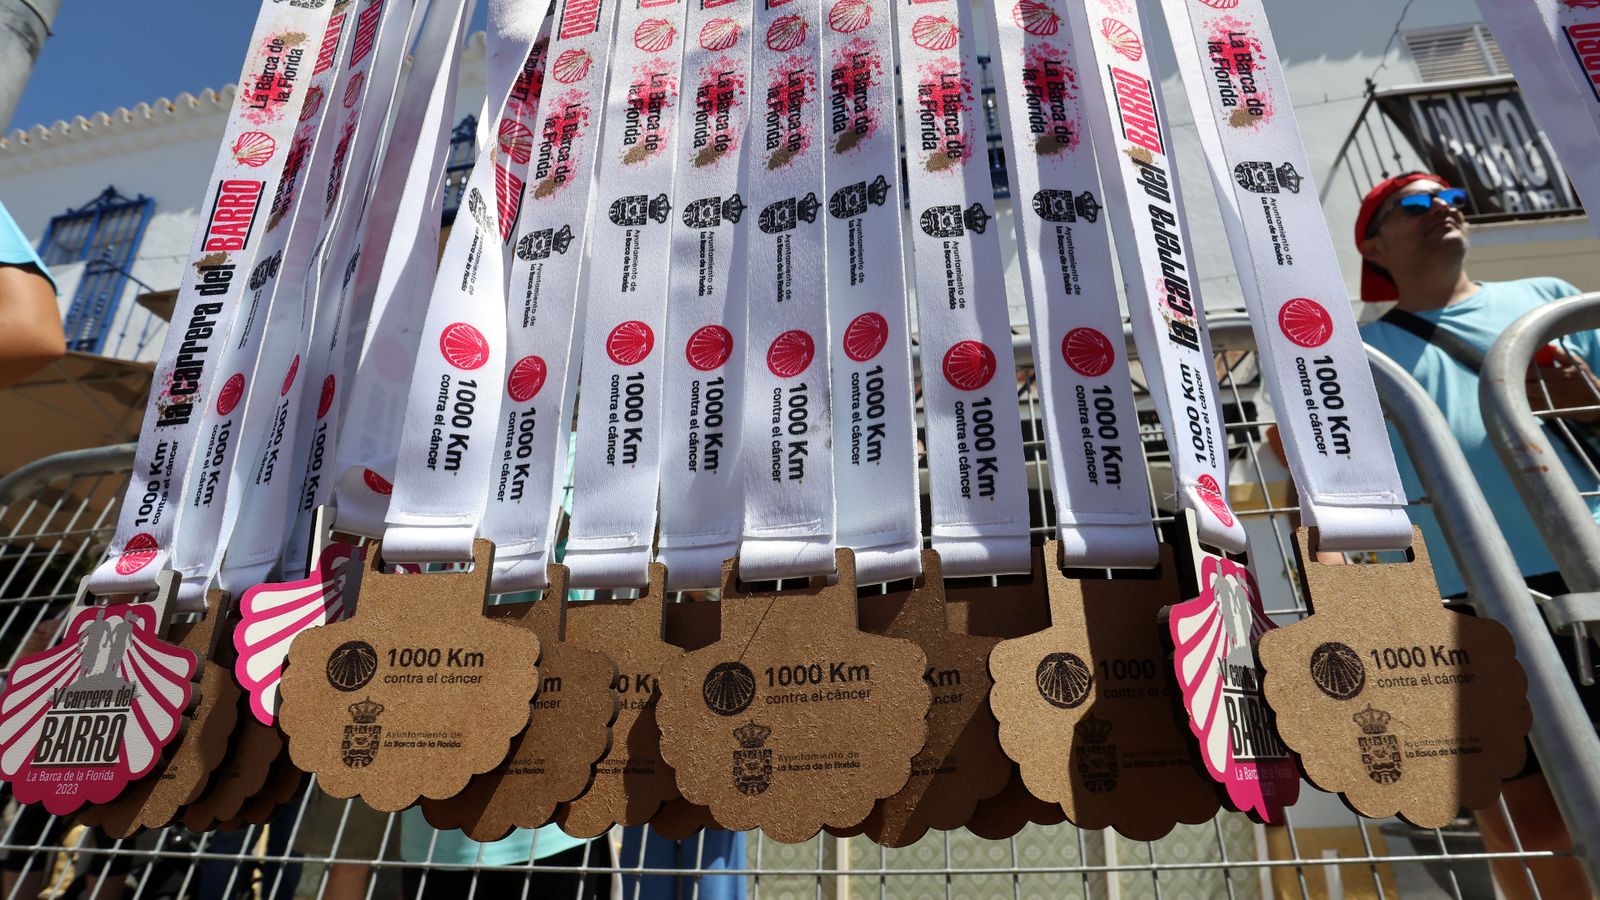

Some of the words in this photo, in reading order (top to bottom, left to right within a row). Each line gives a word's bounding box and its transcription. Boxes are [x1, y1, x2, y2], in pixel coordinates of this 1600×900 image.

[266, 38, 285, 53] de
[1207, 41, 1225, 54] la
[1227, 32, 1246, 49] La
[254, 56, 280, 90] Barca
[276, 48, 303, 88] Florida
[650, 72, 668, 88] La
[717, 71, 735, 89] La
[788, 69, 805, 88] La
[940, 73, 958, 90] La
[1022, 68, 1040, 82] la
[1044, 61, 1062, 77] La
[1213, 58, 1237, 107] Florida
[1235, 53, 1257, 94] Barca
[249, 94, 269, 109] La
[272, 91, 291, 102] la
[628, 83, 645, 96] la
[697, 85, 710, 100] la
[767, 86, 782, 100] la
[919, 84, 936, 97] la
[1045, 81, 1067, 122] Barca
[1246, 98, 1264, 117] de
[623, 98, 644, 145] Florida
[647, 92, 665, 131] Barca
[694, 101, 713, 148] Florida
[716, 91, 734, 132] Barca
[766, 101, 784, 151] Florida
[788, 89, 805, 132] Barca
[920, 100, 938, 151] Florida
[943, 94, 961, 137] Barca
[1026, 85, 1047, 133] Florida
[1112, 67, 1161, 154] BARRO
[644, 135, 661, 152] de
[715, 135, 730, 153] de
[787, 133, 804, 153] de
[947, 140, 963, 160] de
[1054, 126, 1071, 145] de
[1130, 157, 1172, 204] del
[205, 180, 262, 251] BARRO
[1269, 197, 1289, 252] Ayuntamiento
[1285, 255, 1293, 266] de
[631, 230, 641, 280] Ayuntamiento
[1065, 226, 1079, 282] Ayuntamiento
[1074, 284, 1081, 295] de
[1148, 204, 1194, 317] carrera
[195, 264, 236, 297] del
[630, 282, 637, 292] de
[169, 302, 223, 396] carrera
[1169, 320, 1200, 352] la
[436, 374, 450, 411] contra
[609, 374, 620, 411] contra
[851, 372, 861, 410] contra
[865, 365, 885, 419] 1000
[1182, 364, 1196, 402] Km
[1195, 368, 1207, 410] cáncer
[1295, 356, 1312, 396] contra
[1313, 355, 1344, 410] 1000
[156, 402, 192, 428] la
[451, 379, 477, 428] 1000
[624, 371, 644, 422] 1000
[690, 380, 700, 417] contra
[704, 376, 724, 428] 1000
[772, 387, 782, 424] contra
[787, 382, 808, 435] 1000
[1075, 384, 1089, 424] contra
[1092, 385, 1118, 440] 1000
[1305, 398, 1319, 410] el
[274, 399, 289, 446] 1000
[433, 414, 445, 425] el
[505, 411, 516, 448] contra
[516, 407, 536, 458] 1000
[608, 412, 619, 424] el
[689, 418, 699, 430] el
[771, 426, 783, 438] el
[851, 411, 862, 423] el
[954, 400, 967, 440] contra
[971, 396, 996, 452] 1000
[1081, 426, 1094, 439] el
[1186, 406, 1207, 464] 1000
[1203, 412, 1210, 424] el
[1308, 412, 1327, 456] cáncer
[1327, 415, 1351, 455] Km
[166, 441, 179, 477] cáncer
[206, 424, 219, 459] contra
[214, 419, 233, 467] 1000
[312, 422, 327, 471] 1000
[426, 427, 443, 471] cáncer
[443, 433, 469, 472] Km
[503, 450, 512, 461] el
[606, 425, 618, 466] cáncer
[622, 427, 642, 465] Km
[688, 431, 699, 472] cáncer
[703, 432, 723, 471] Km
[788, 440, 808, 481] Km
[851, 425, 862, 465] cáncer
[866, 422, 885, 463] Km
[957, 441, 970, 454] el
[1205, 427, 1217, 468] contra
[263, 448, 280, 483] Km
[771, 440, 783, 483] cáncer
[958, 456, 971, 499] cáncer
[976, 456, 998, 497] Km
[1083, 440, 1098, 485] cáncer
[1100, 445, 1123, 485] Km
[135, 480, 161, 527] 1000
[149, 442, 168, 476] Km
[160, 479, 171, 491] el
[194, 471, 207, 508] cáncer
[203, 470, 221, 506] Km
[305, 474, 320, 511] Km
[496, 463, 510, 502] cáncer
[509, 463, 530, 501] Km
[152, 491, 169, 525] contra
[387, 648, 441, 667] 1000
[448, 648, 485, 668] Km
[765, 665, 822, 688] 1000
[830, 662, 870, 684] Km
[1370, 648, 1426, 671] 1000
[1431, 646, 1470, 668] Km
[52, 687, 65, 710] V
[64, 690, 113, 709] carrera
[115, 684, 137, 708] del
[384, 674, 424, 684] contra
[427, 673, 438, 684] el
[441, 672, 482, 684] cáncer
[766, 692, 808, 706] contra
[811, 690, 821, 703] el
[825, 688, 871, 702] cáncer
[1378, 672, 1418, 688] contra
[1421, 671, 1433, 686] el
[1435, 672, 1475, 686] cáncer
[33, 714, 127, 763] BARRO
[26, 770, 37, 782] La
[39, 770, 62, 782] Barca
[64, 770, 74, 781] de
[76, 769, 84, 781] la
[86, 769, 115, 781] Florida
[55, 783, 78, 795] 2023
